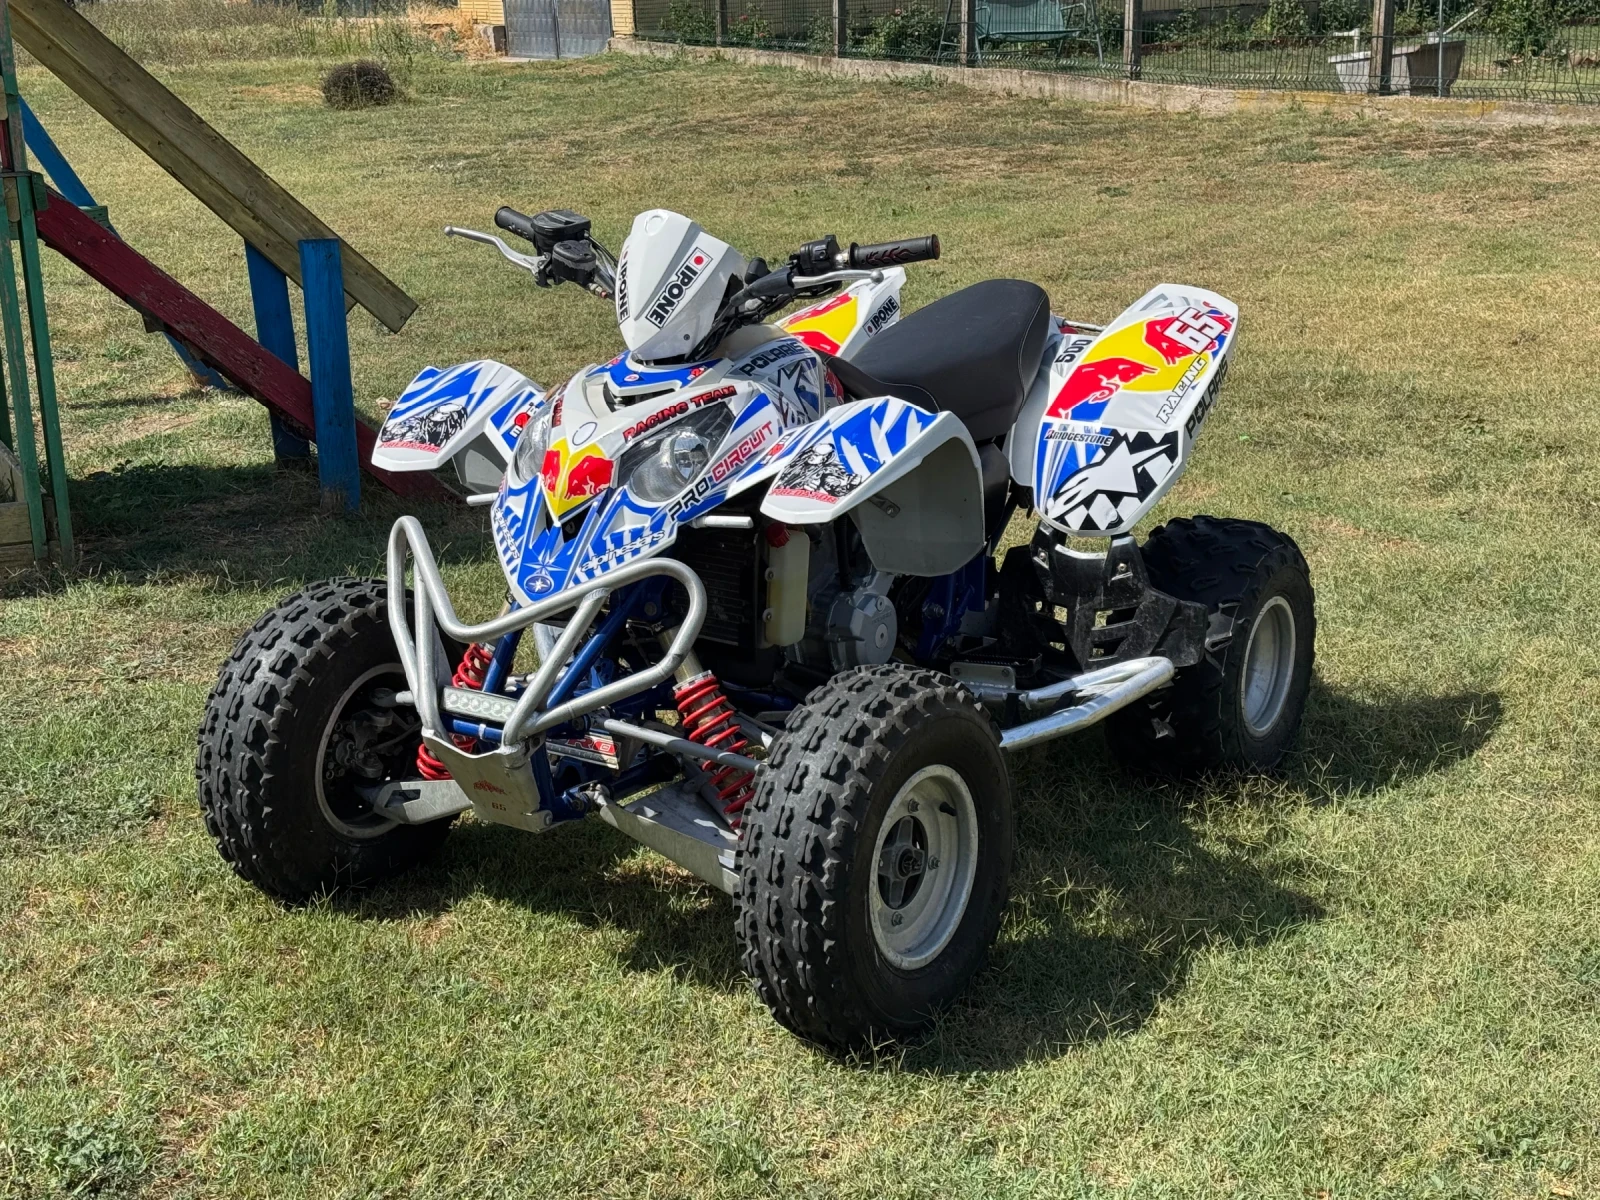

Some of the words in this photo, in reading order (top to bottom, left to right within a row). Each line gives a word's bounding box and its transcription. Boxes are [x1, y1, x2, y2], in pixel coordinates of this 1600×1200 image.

[618, 260, 629, 321] IPONE
[649, 264, 699, 325] IPONE
[871, 298, 897, 331] IPONE
[739, 341, 808, 377] POLARIS
[1054, 339, 1093, 363] 500
[1162, 307, 1228, 354] 65
[622, 401, 689, 444] RACING
[690, 385, 738, 408] TEAM
[1156, 354, 1208, 424] RACING
[1185, 354, 1229, 440] POLARIS
[1044, 429, 1114, 447] BRIDGESTONE
[667, 476, 711, 522] PRO
[711, 420, 773, 483] CIRCUIT
